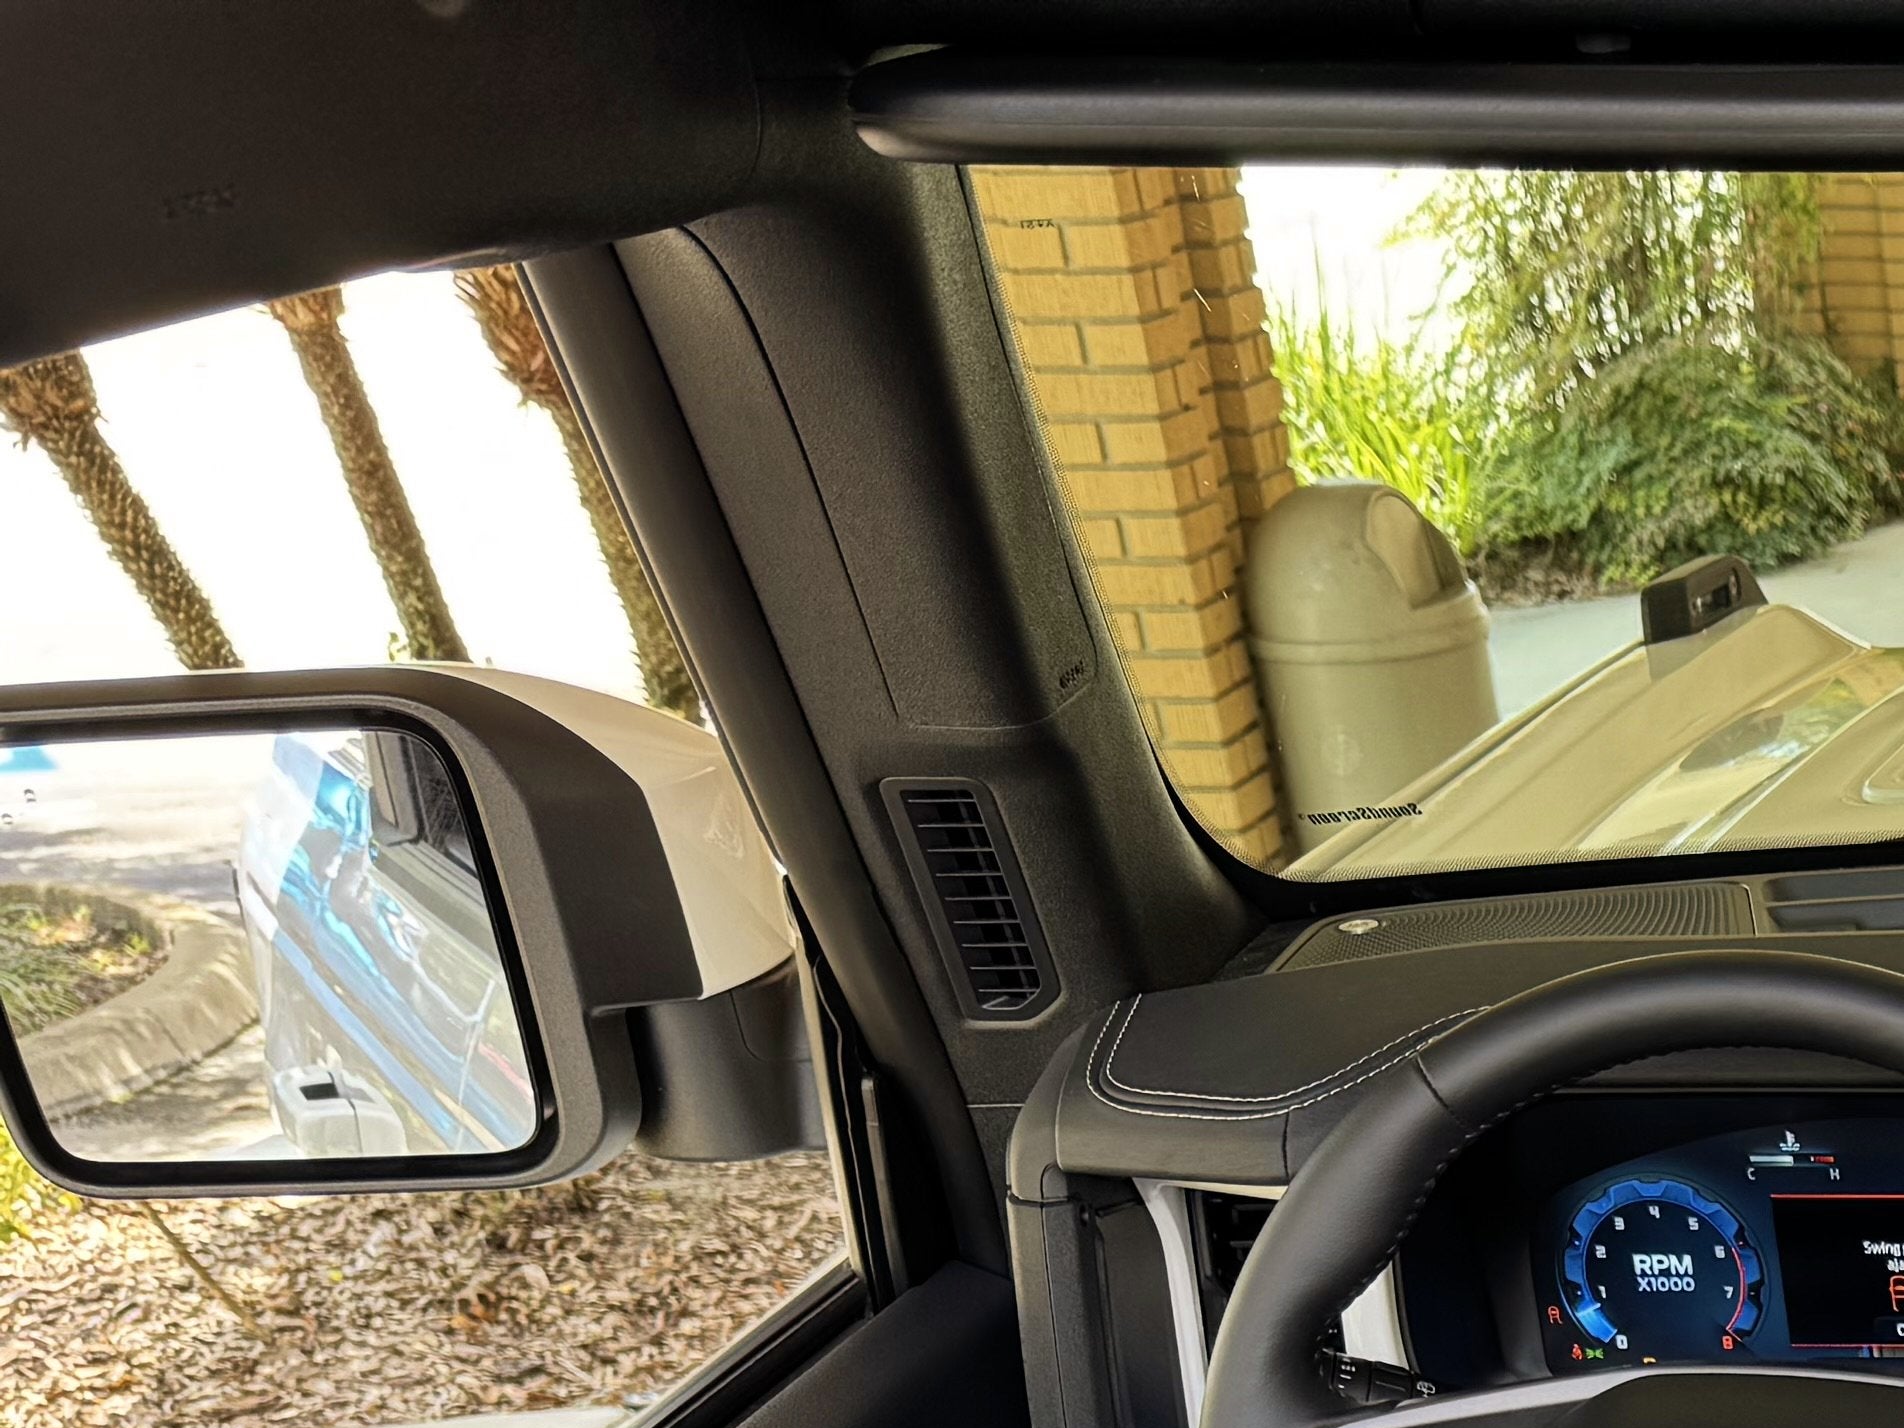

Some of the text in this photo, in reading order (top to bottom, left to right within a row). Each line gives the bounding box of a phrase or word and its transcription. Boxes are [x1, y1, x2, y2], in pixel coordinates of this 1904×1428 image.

[1747, 1168, 1756, 1180] C
[1829, 1168, 1840, 1181] H
[1649, 1205, 1660, 1218] 4
[1613, 1216, 1625, 1230] 3
[1688, 1216, 1699, 1230] 5
[1596, 1246, 1607, 1258] 2
[1715, 1246, 1726, 1258] 6
[1862, 1240, 1901, 1257] Swing
[1632, 1253, 1694, 1275] RPM
[1636, 1277, 1696, 1292] X1000
[1598, 1286, 1607, 1298] 1
[1724, 1286, 1733, 1298] 7
[1615, 1334, 1628, 1349] 0
[1722, 1336, 1733, 1350] 8
